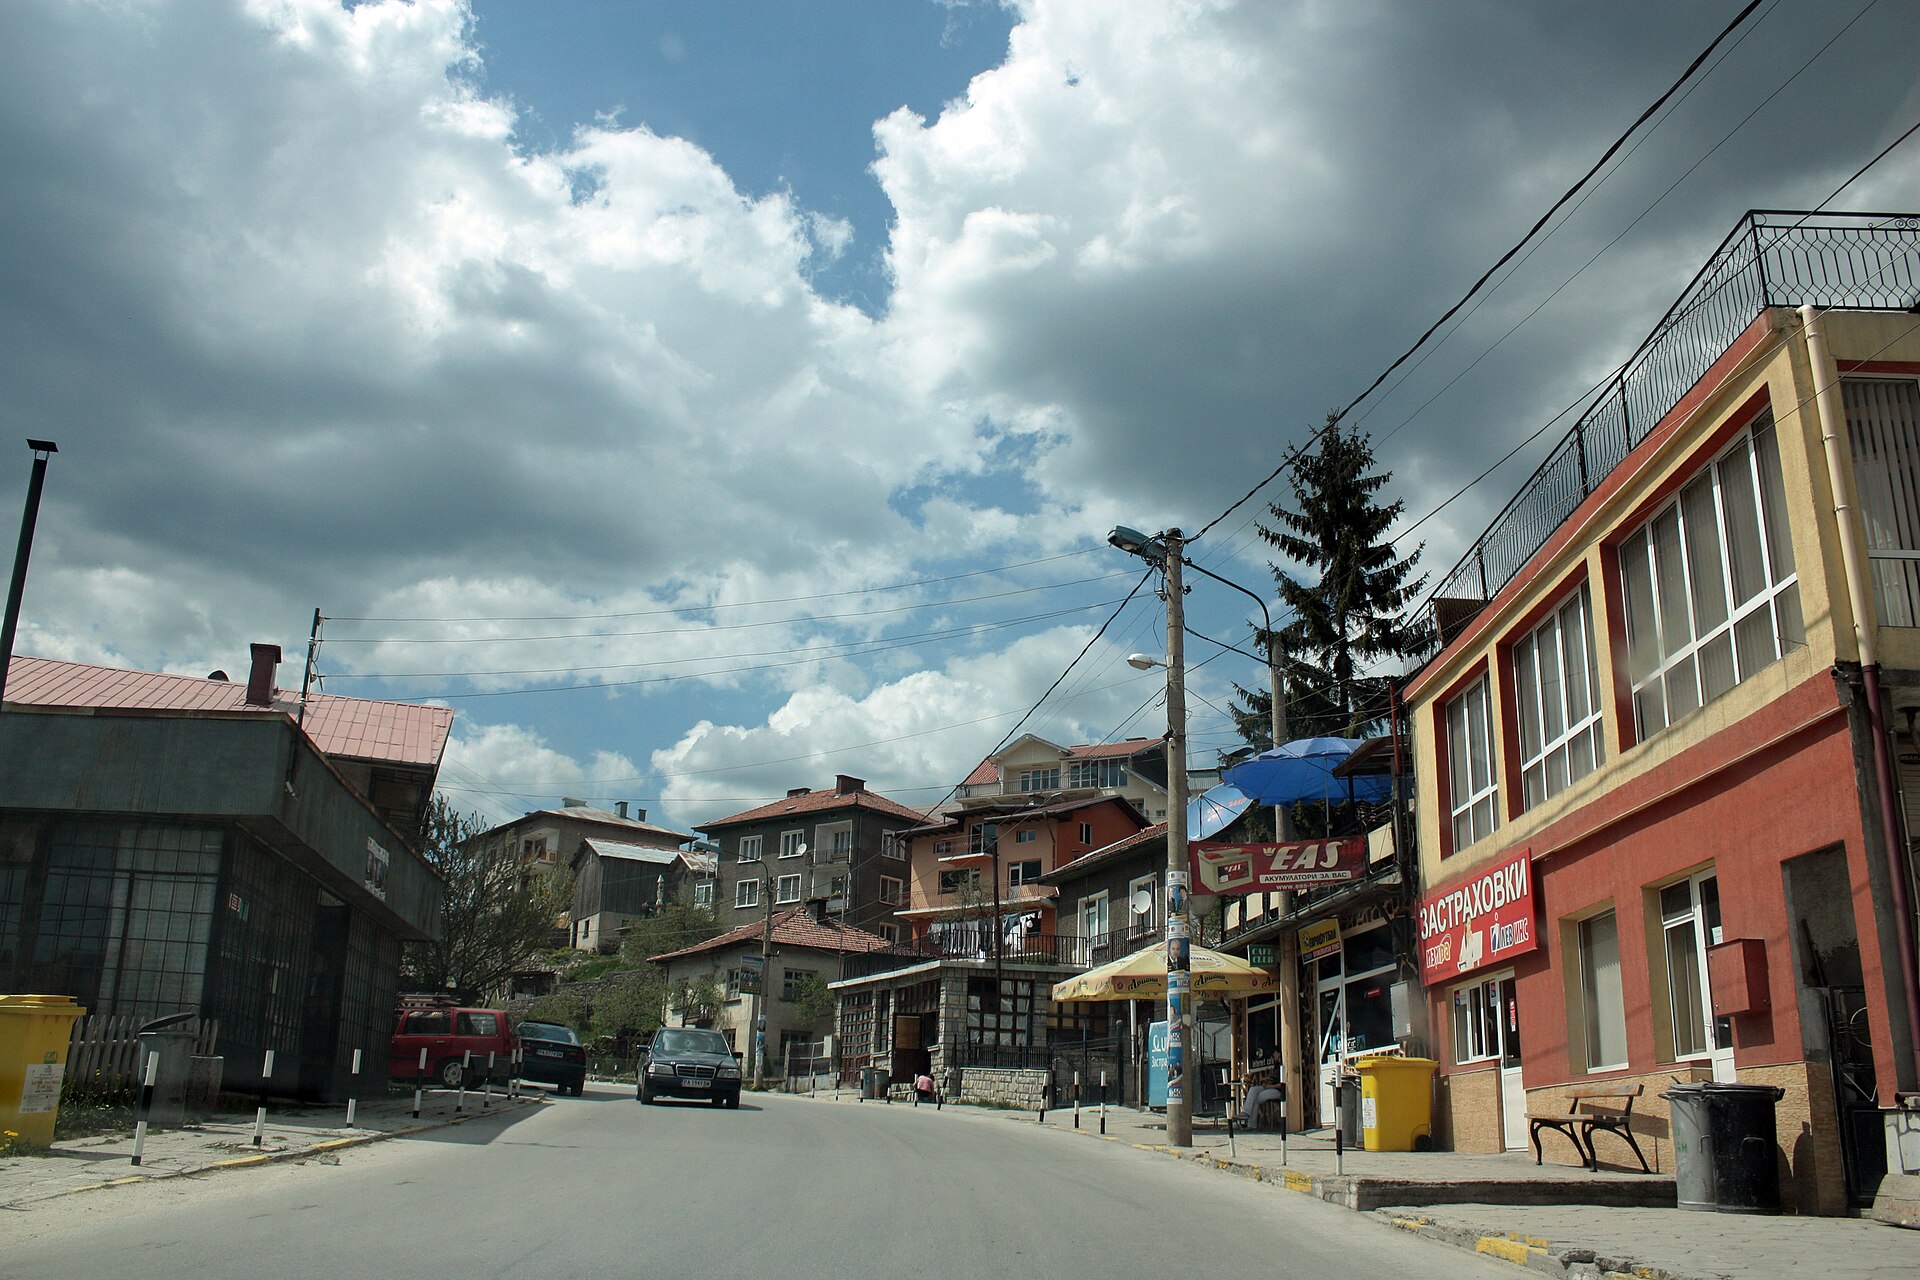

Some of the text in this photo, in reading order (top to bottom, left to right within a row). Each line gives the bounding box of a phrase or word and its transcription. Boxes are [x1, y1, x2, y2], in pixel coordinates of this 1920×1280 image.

[1270, 841, 1343, 870] EAS
[1264, 873, 1318, 882] АКУМУЛАТОРИ
[1419, 857, 1528, 940] ЗАСТРАХОВКИ
